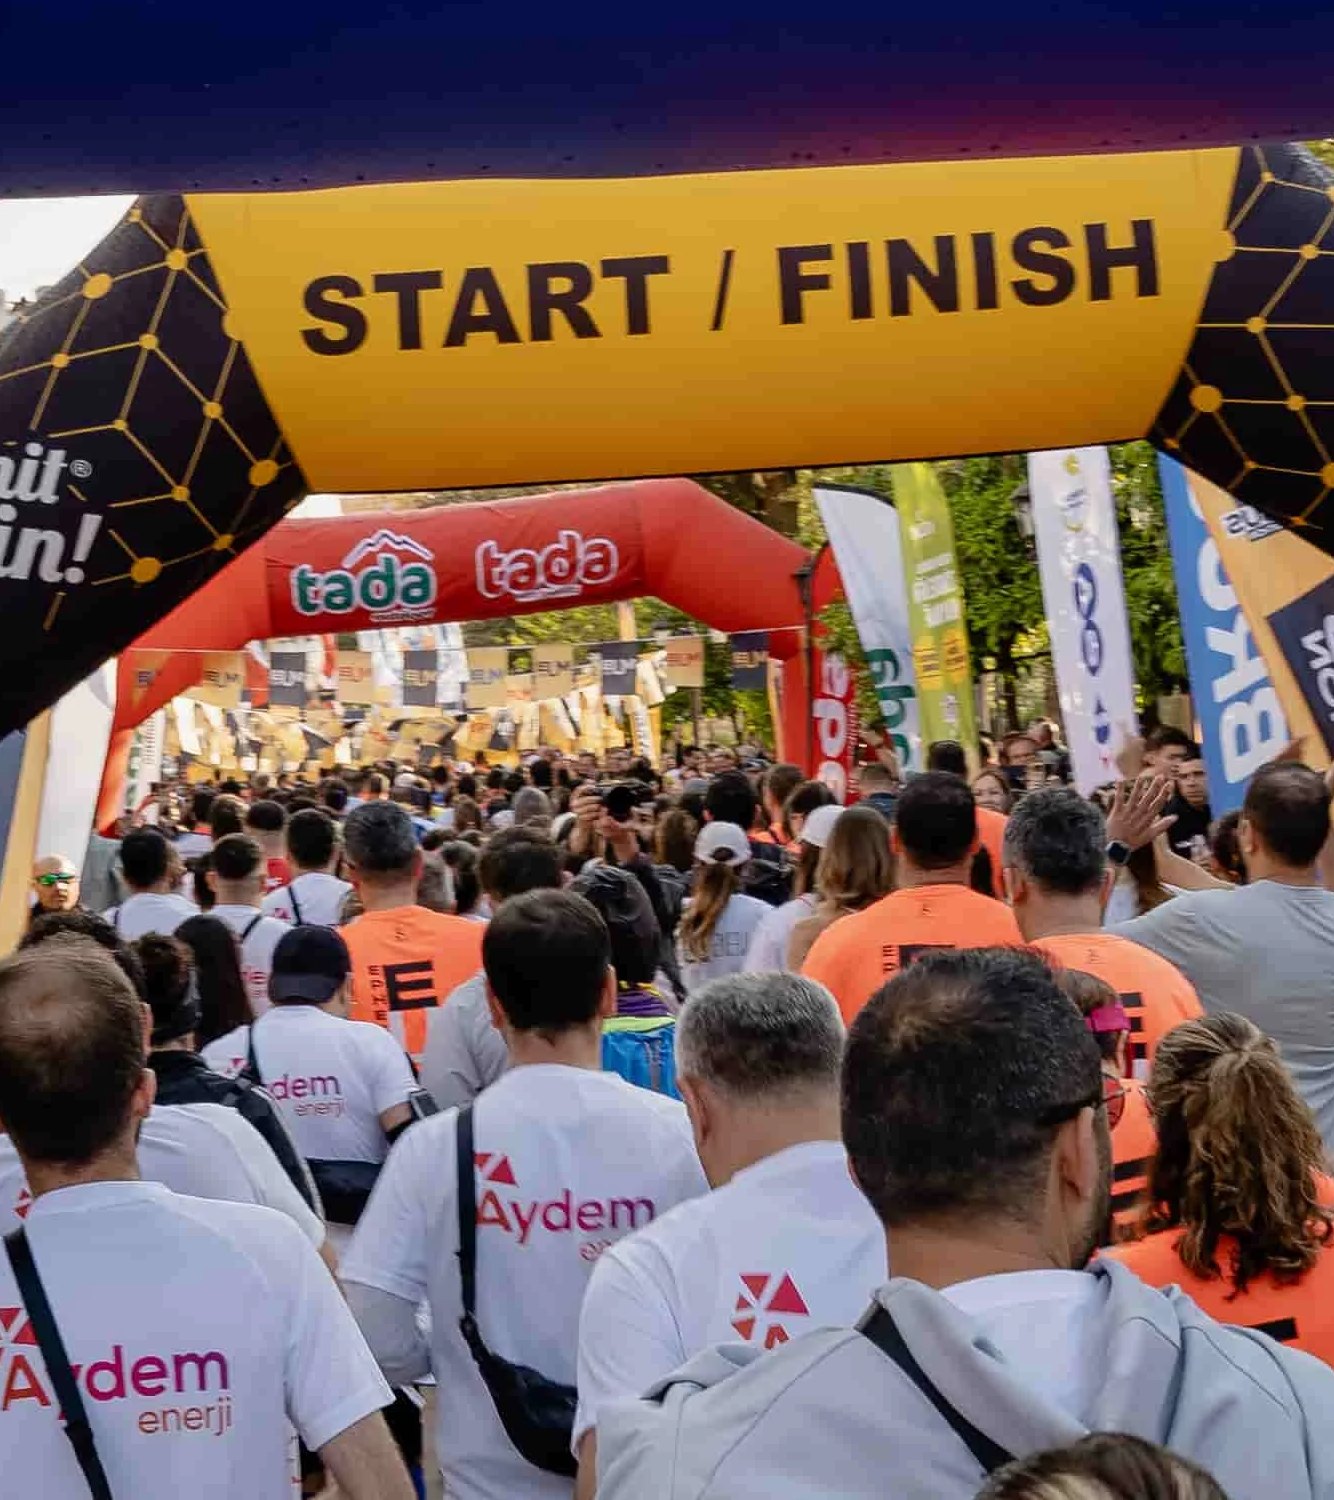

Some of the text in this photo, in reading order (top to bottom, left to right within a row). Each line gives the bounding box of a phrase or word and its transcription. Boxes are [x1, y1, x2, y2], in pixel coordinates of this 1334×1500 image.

[300, 255, 671, 356] START
[776, 219, 1161, 325] FINISH
[291, 552, 437, 616] tada
[475, 530, 619, 599] tada
[475, 1188, 657, 1245] Aydem
[1, 1344, 231, 1422] Adem
[138, 1397, 233, 1436] enerji
